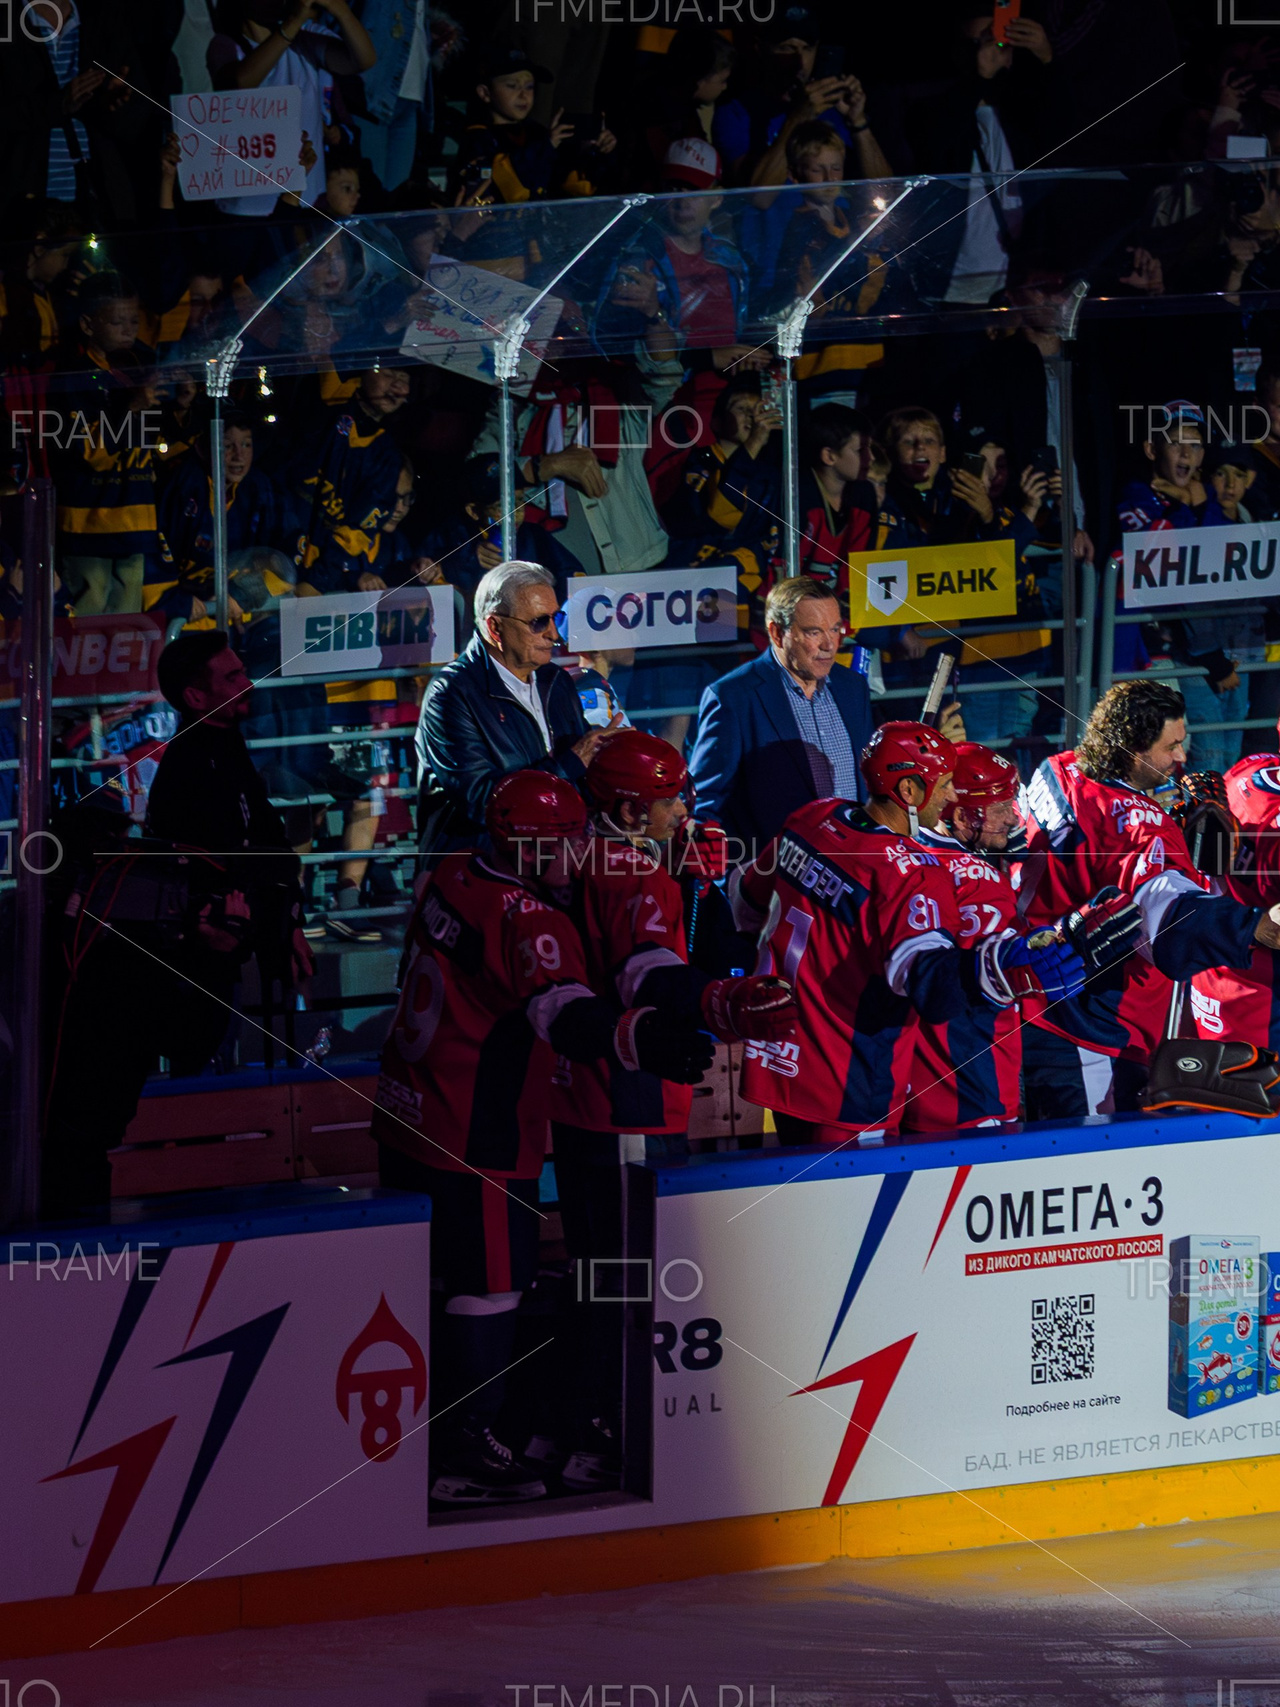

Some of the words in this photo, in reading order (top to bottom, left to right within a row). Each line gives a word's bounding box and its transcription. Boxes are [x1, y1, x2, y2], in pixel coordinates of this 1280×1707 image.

[188, 95, 288, 125] ОВЕЧКИН
[187, 166, 224, 195] ДАЙ
[234, 163, 294, 188] ШАЙБУ
[1132, 538, 1277, 589] KHL.RU
[916, 567, 999, 597] БАНК
[304, 607, 431, 654] SIBUR
[1117, 808, 1164, 834] FON
[953, 866, 1001, 887] FON
[907, 893, 942, 931] 81
[958, 903, 1002, 937] 37
[516, 933, 562, 978] 39
[968, 1258, 984, 1272] ИЗ
[986, 1253, 1032, 1273] ДИКОГО
[1033, 1244, 1114, 1265] КАМЧАТСКОГО
[1116, 1239, 1161, 1257] ЛОСОСЯ
[1006, 1401, 1070, 1418] Подробнее
[1073, 1400, 1087, 1410] на
[1089, 1394, 1121, 1407] сайте
[964, 1452, 1012, 1473] БАД.
[1018, 1447, 1046, 1466] НЕ
[1052, 1434, 1160, 1463] ЯВЛЯЕТСЯ
